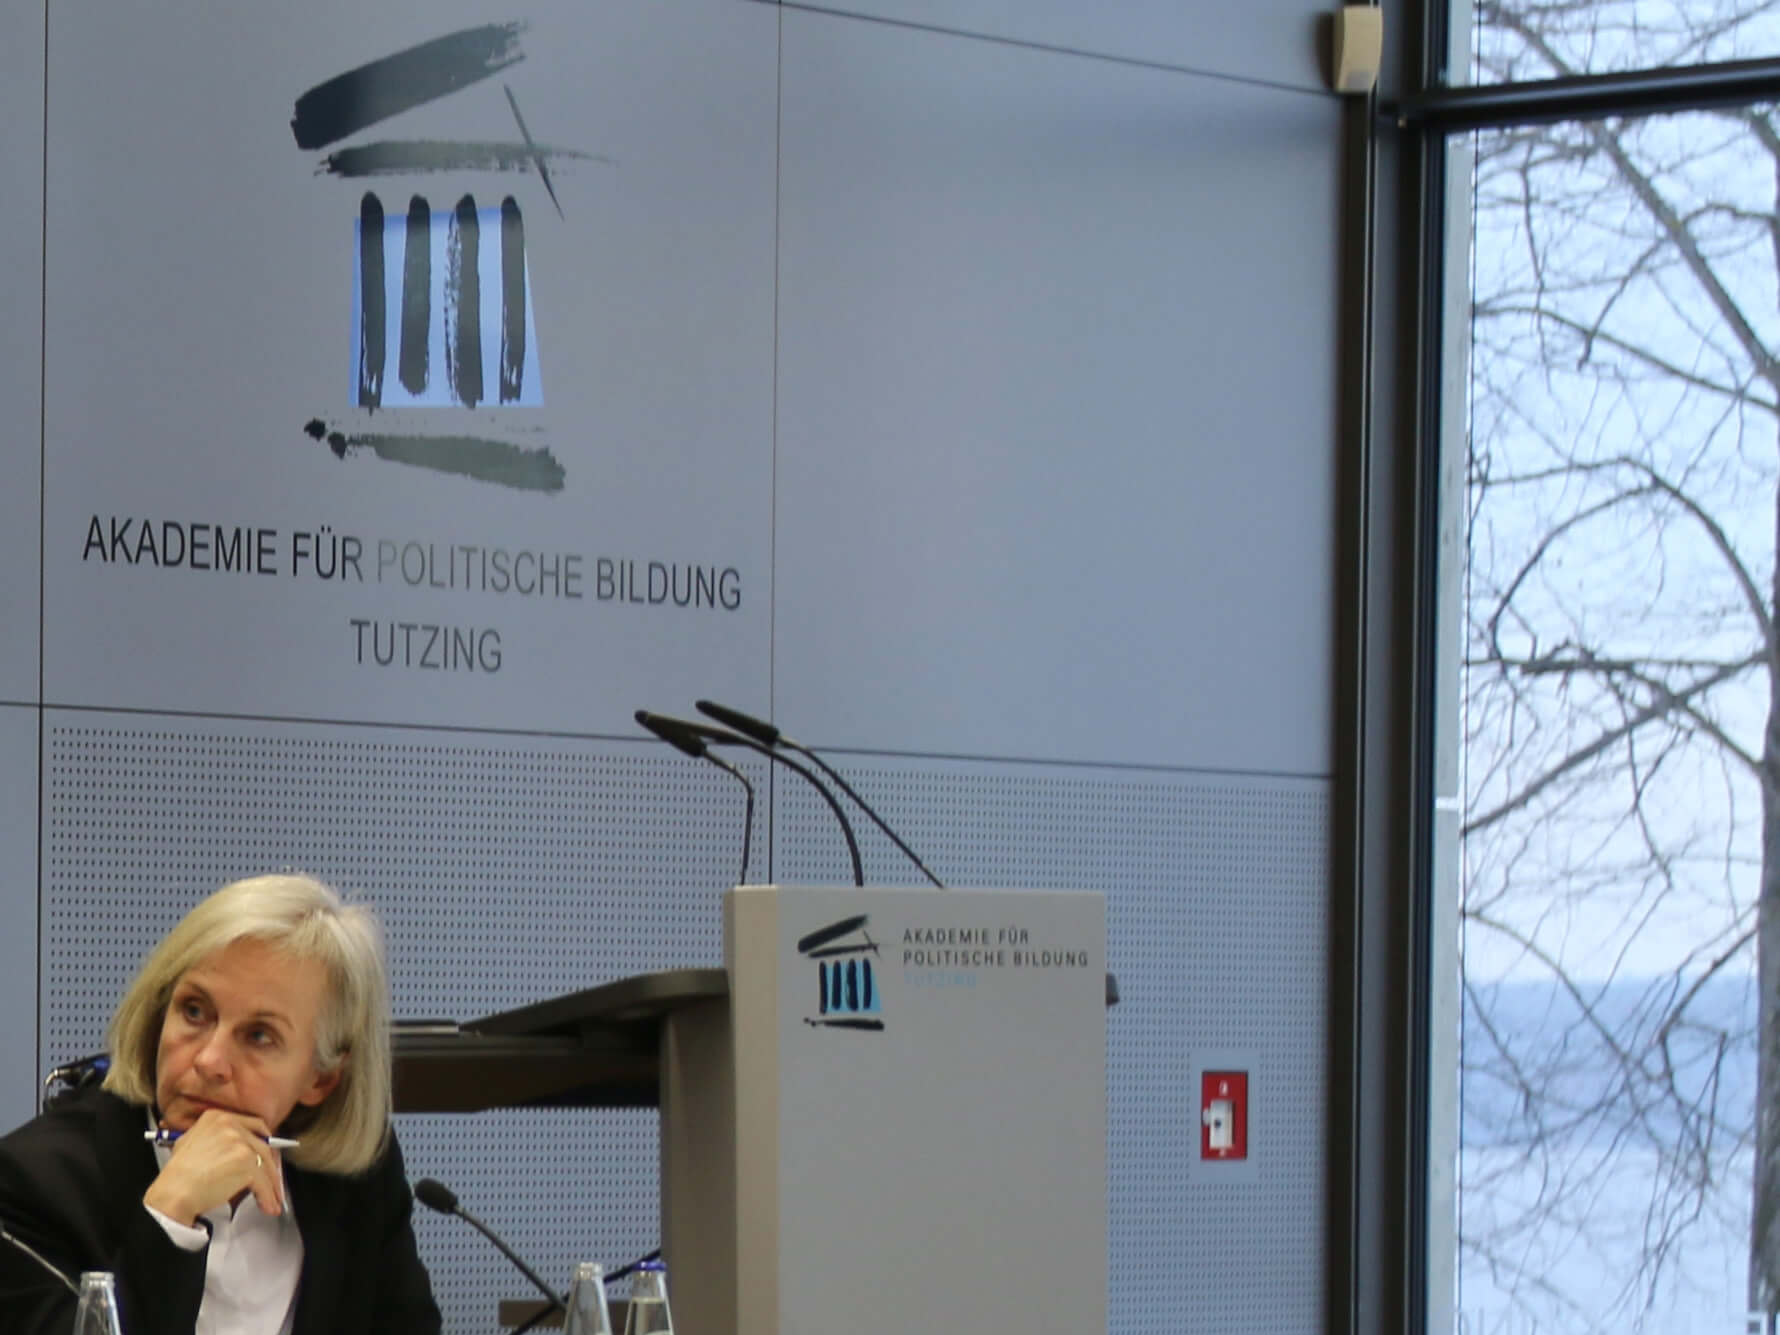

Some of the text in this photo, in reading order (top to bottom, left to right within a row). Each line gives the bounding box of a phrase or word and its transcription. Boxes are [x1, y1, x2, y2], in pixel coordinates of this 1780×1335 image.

[82, 515, 742, 611] AKADEMIE FÜR POLITISCHE BILDUNG
[350, 619, 502, 672] TUTZING
[903, 926, 1030, 945] AKADEMIE FÜR
[903, 950, 1089, 968] POLITISCHE BILDUNG
